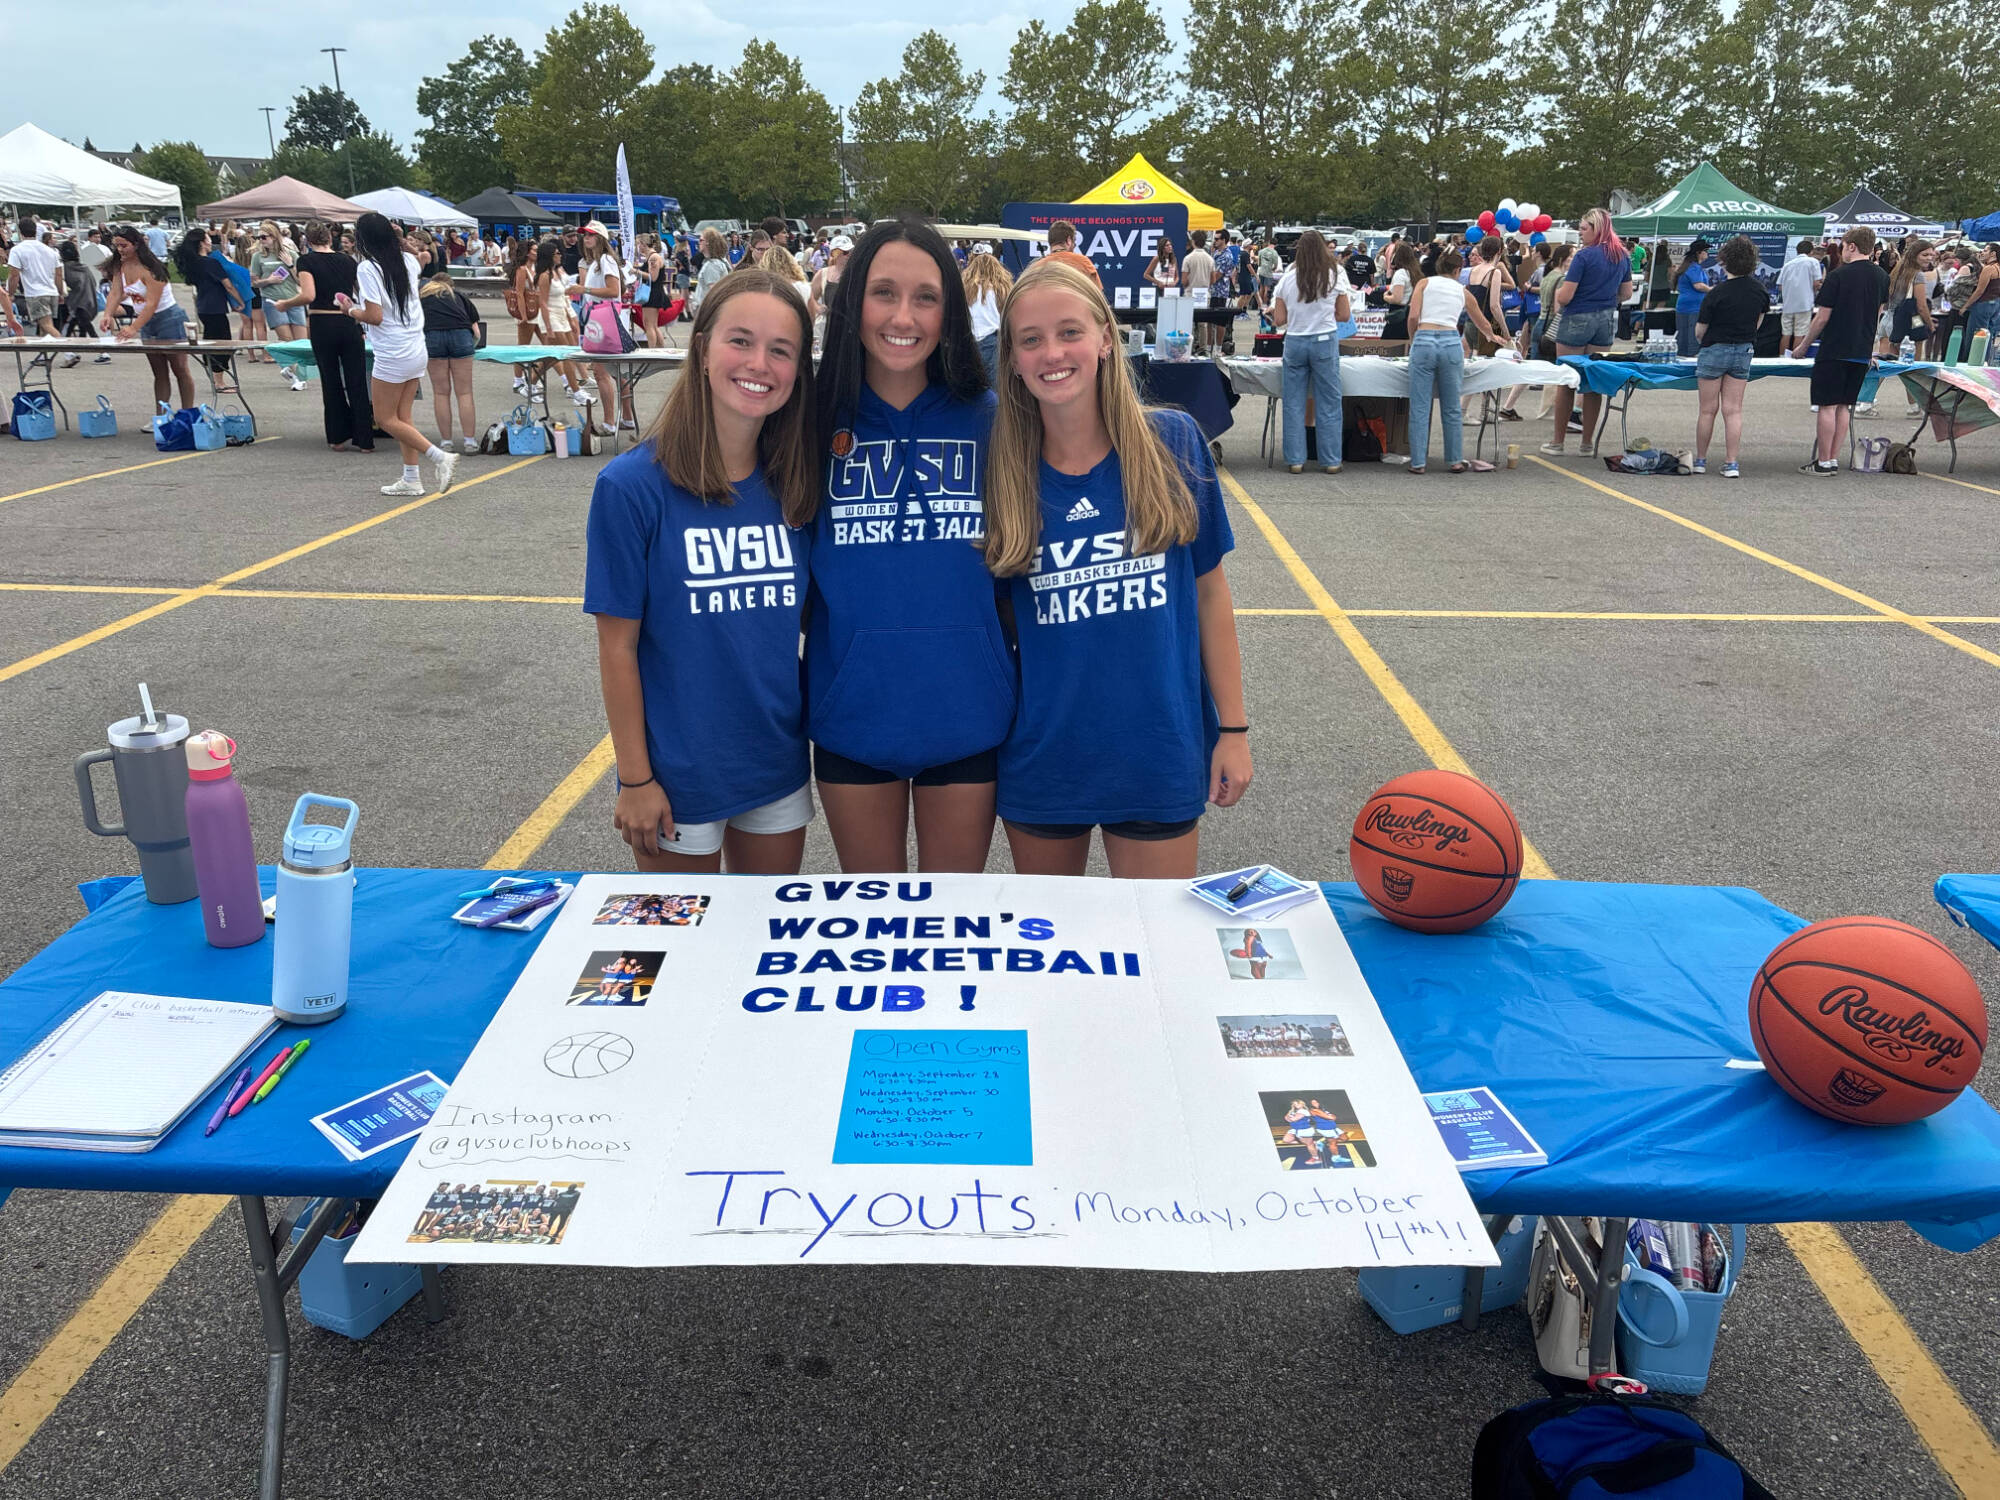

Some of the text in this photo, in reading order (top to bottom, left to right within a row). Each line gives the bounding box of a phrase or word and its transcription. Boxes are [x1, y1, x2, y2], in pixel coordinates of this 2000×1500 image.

[1685, 200, 1779, 213] ARBOR
[1031, 216, 1048, 224] THE
[1088, 217, 1131, 225] BELONGS
[1147, 216, 1164, 224] THE
[1688, 222, 1796, 231] MOREWITHARBOR.ORG
[829, 439, 977, 501] GVSU
[932, 501, 970, 511] CLUB
[1066, 509, 1100, 522] adidas
[684, 524, 794, 575] GVSU
[1028, 530, 1141, 573] VS
[1034, 557, 1156, 589] CLUB BASKETBALL
[690, 584, 796, 614] LAKERS
[1034, 572, 1167, 625] LAKERS
[1364, 804, 1472, 850] Rawlings
[775, 881, 933, 902] GVSU
[217, 905, 226, 929] owala
[768, 912, 1056, 940] WOMEN'S
[306, 995, 334, 1006] YETI
[741, 985, 926, 1013] CLUB
[1818, 985, 1965, 1068] Rawlings
[864, 1034, 1021, 1058] Open Gyms
[983, 1088, 999, 1096] 30
[907, 1107, 955, 1116] October
[963, 1107, 974, 1116] 5
[1440, 1114, 1494, 1125] BASKETBALL
[1472, 1109, 1494, 1117] CLUB
[923, 1130, 970, 1139] October
[975, 1131, 983, 1139] 7
[429, 1134, 631, 1160] @gvsuclubhoops
[1075, 1190, 1246, 1231] Monday,
[1256, 1187, 1423, 1221] October
